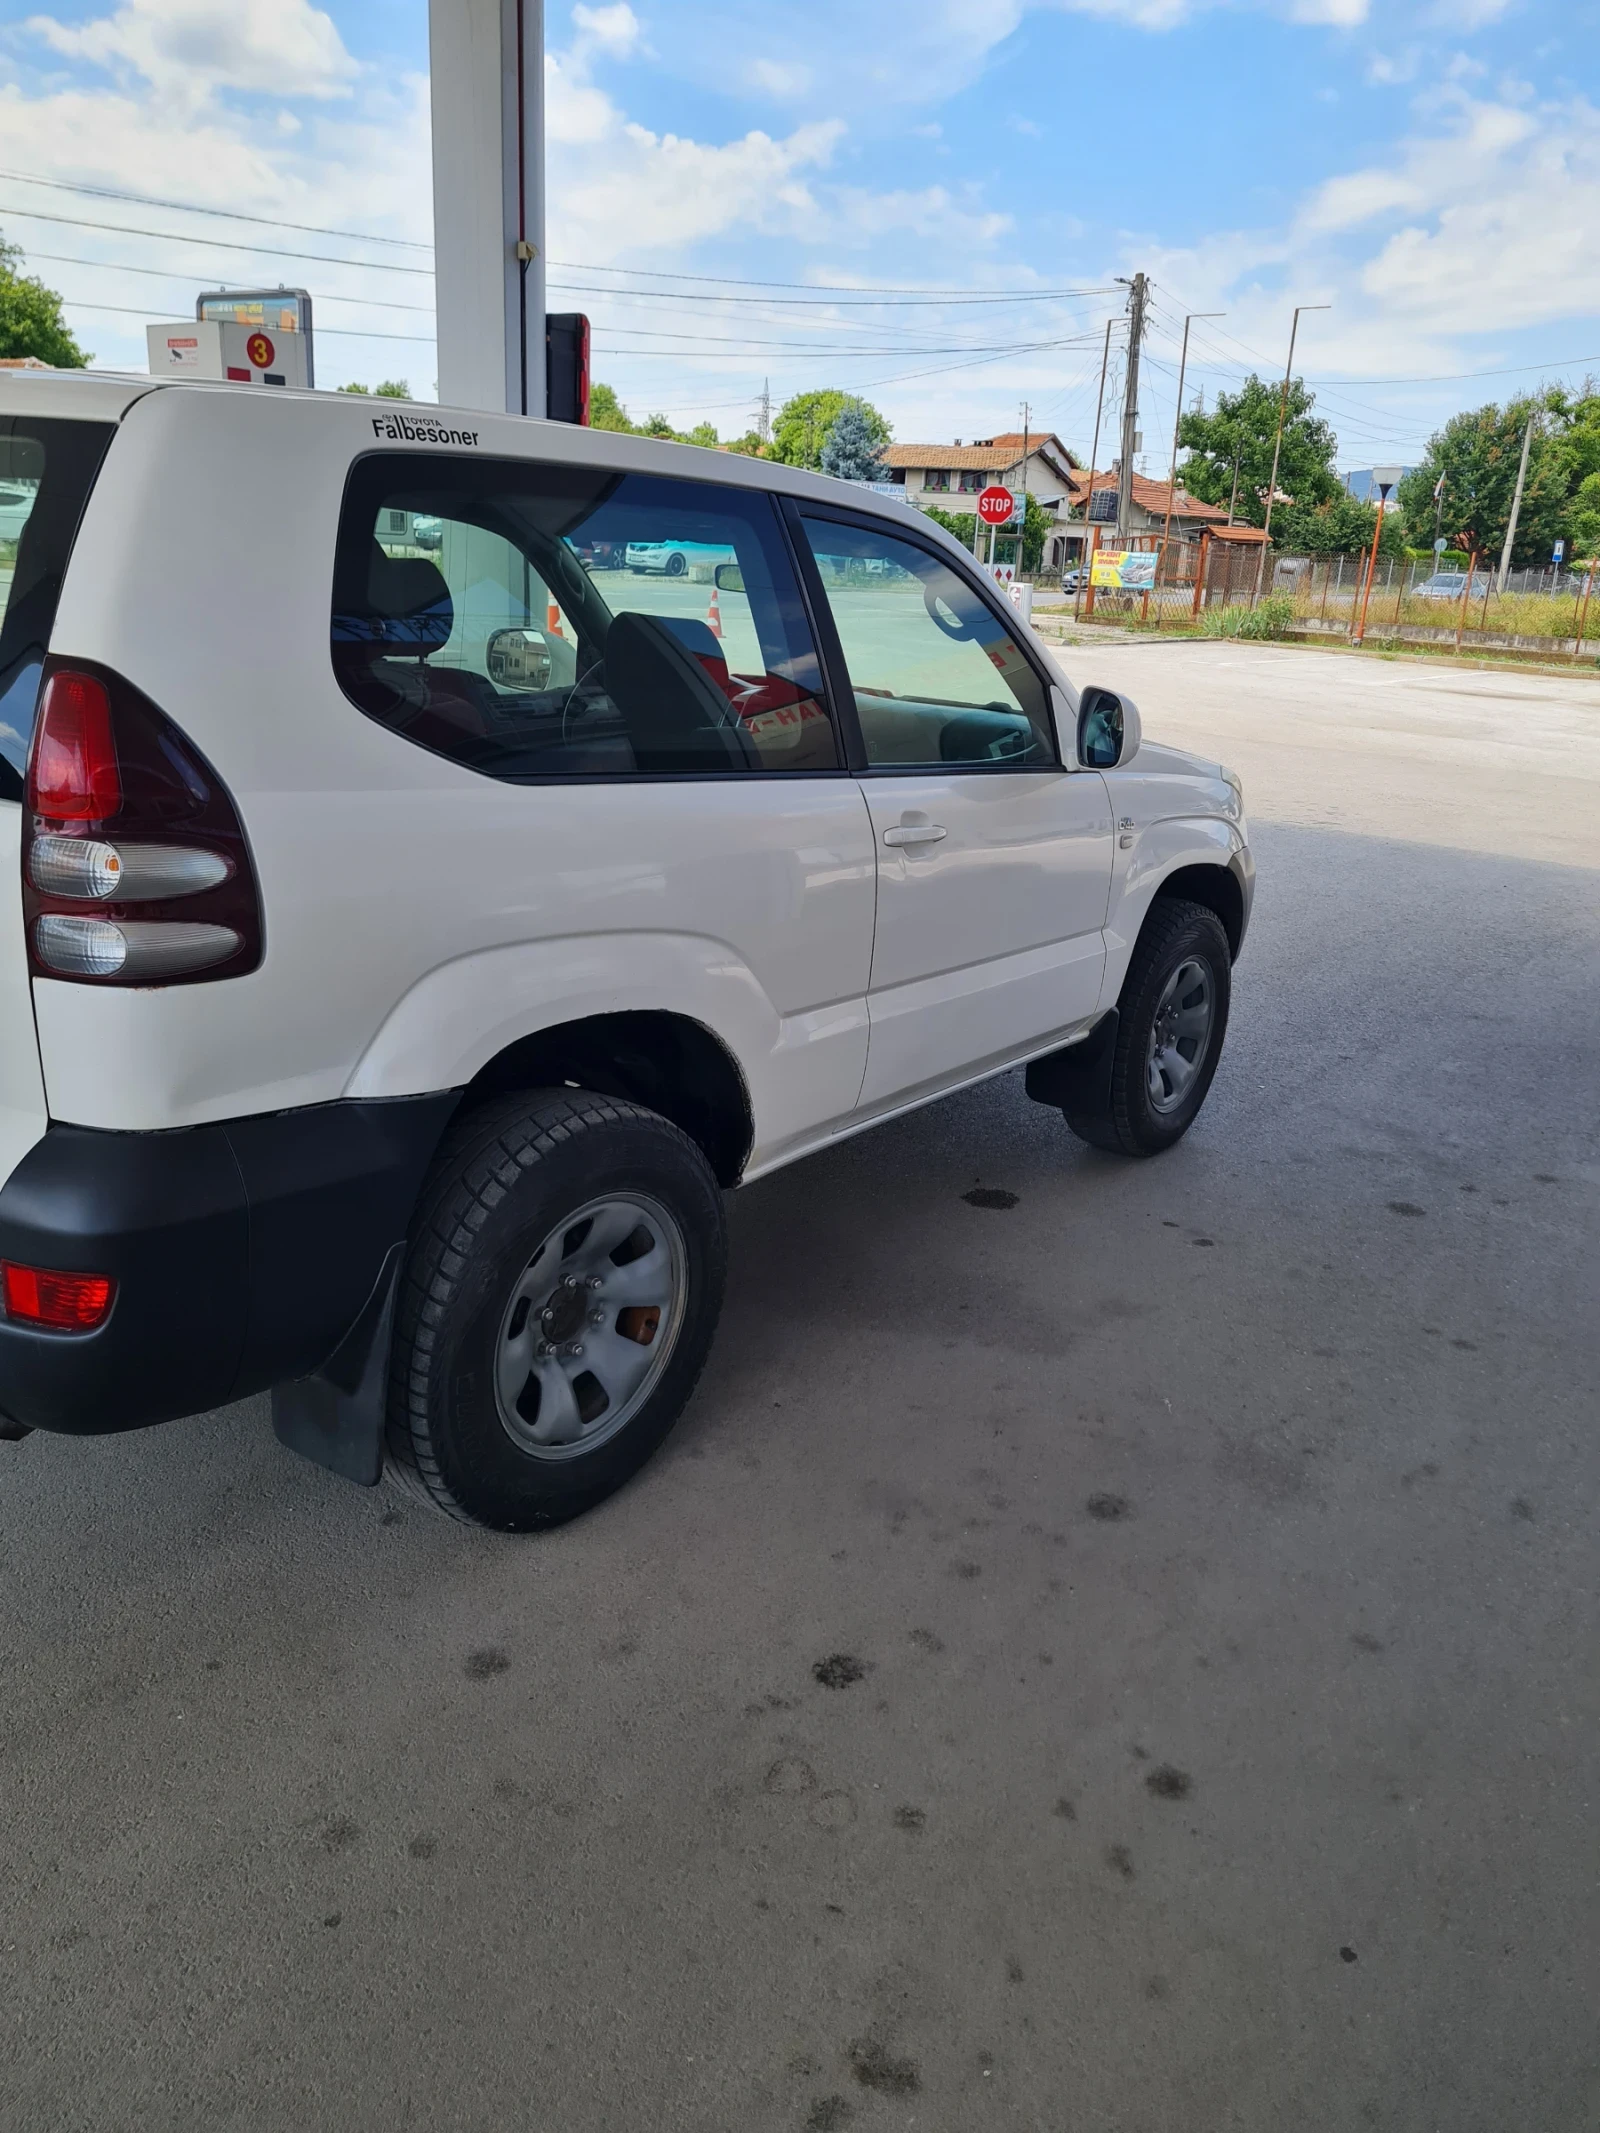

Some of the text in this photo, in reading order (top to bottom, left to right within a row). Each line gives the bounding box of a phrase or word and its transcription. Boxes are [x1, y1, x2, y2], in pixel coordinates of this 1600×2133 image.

[253, 339, 268, 364] 3
[371, 414, 479, 446] Falbesoner
[404, 416, 443, 427] TOYOTA
[981, 497, 1011, 513] STOP
